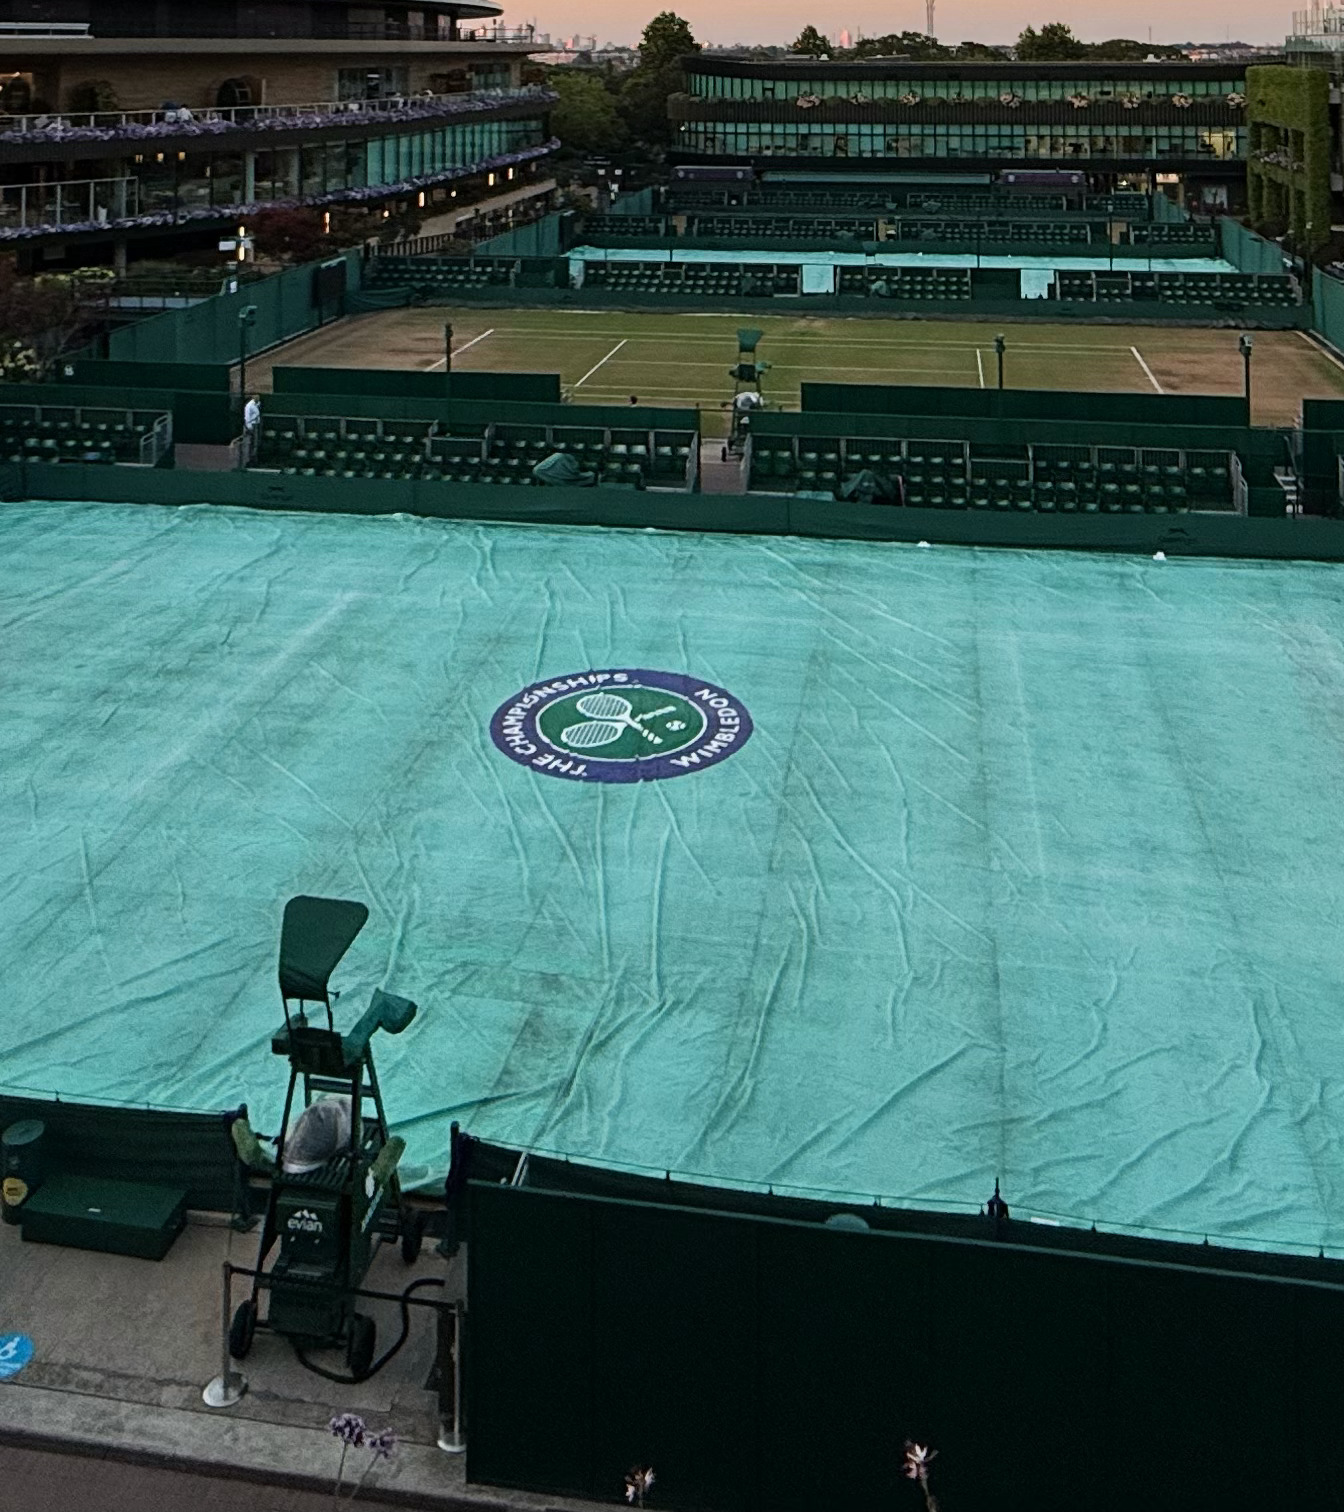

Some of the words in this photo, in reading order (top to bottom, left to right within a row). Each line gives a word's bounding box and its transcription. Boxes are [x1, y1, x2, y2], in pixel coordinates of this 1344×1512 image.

[669, 688, 741, 768] WIMBLEDON
[533, 752, 588, 777] THE
[287, 1218, 323, 1233] evian
